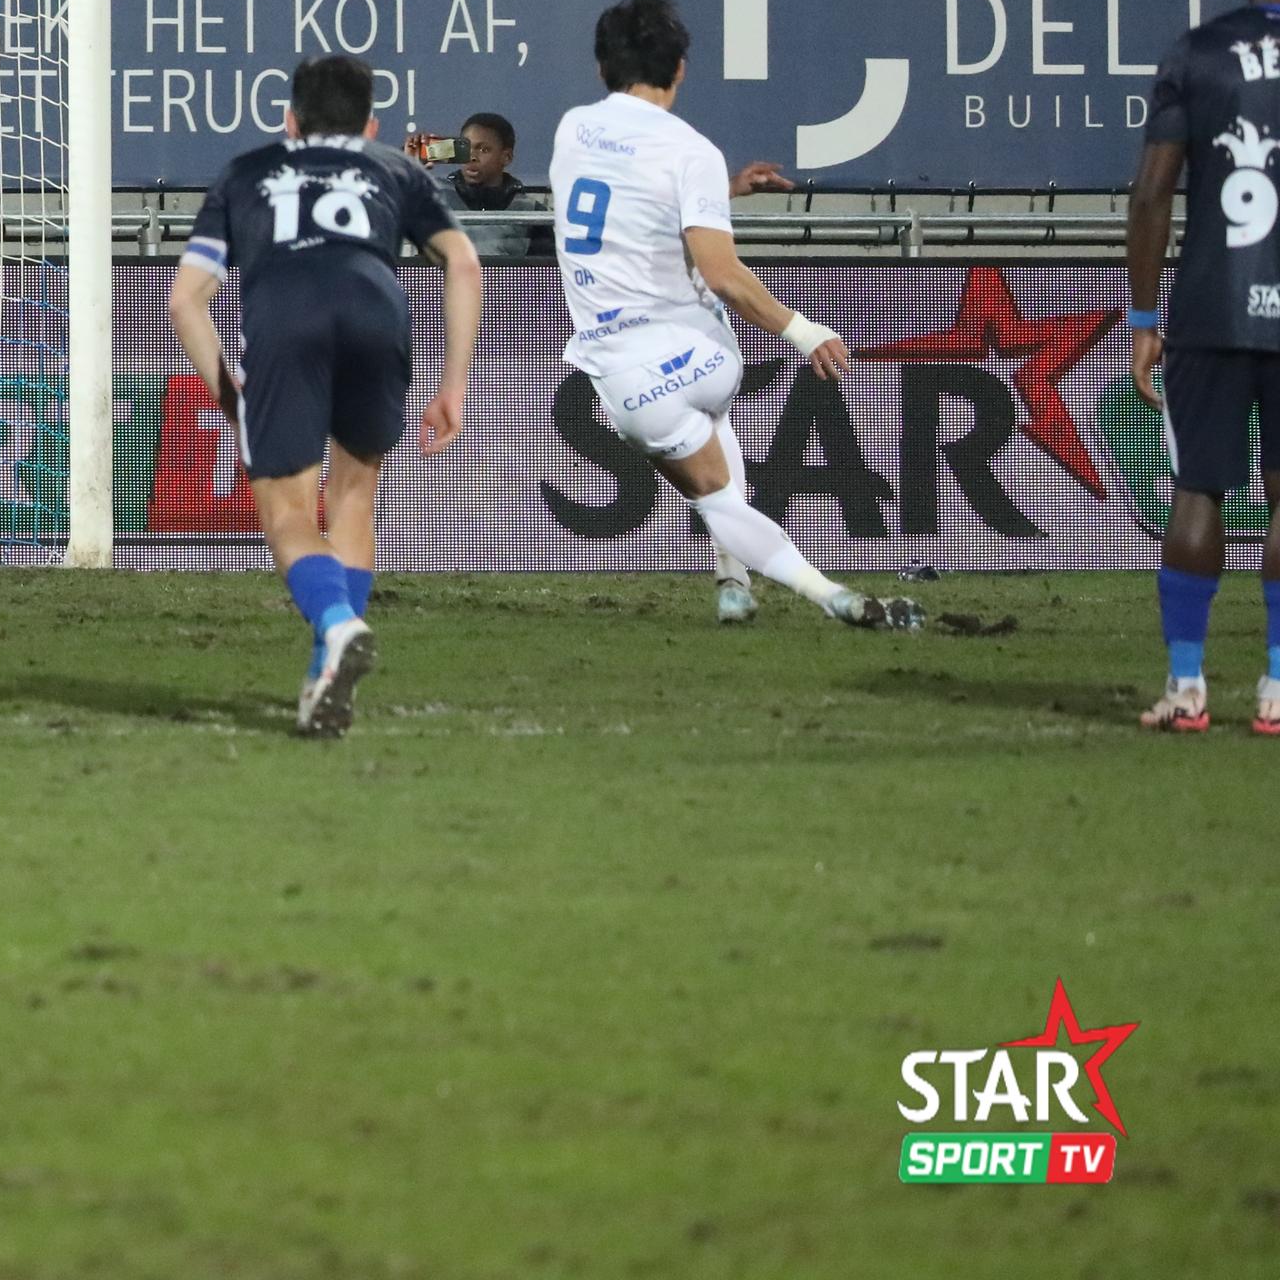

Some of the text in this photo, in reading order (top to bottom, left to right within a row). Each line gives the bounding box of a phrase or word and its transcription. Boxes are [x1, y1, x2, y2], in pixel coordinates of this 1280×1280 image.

[109, 69, 291, 134] ERUG
[564, 176, 612, 256] 9
[579, 314, 651, 344] ARGLASS
[622, 351, 726, 412] CARGLASS
